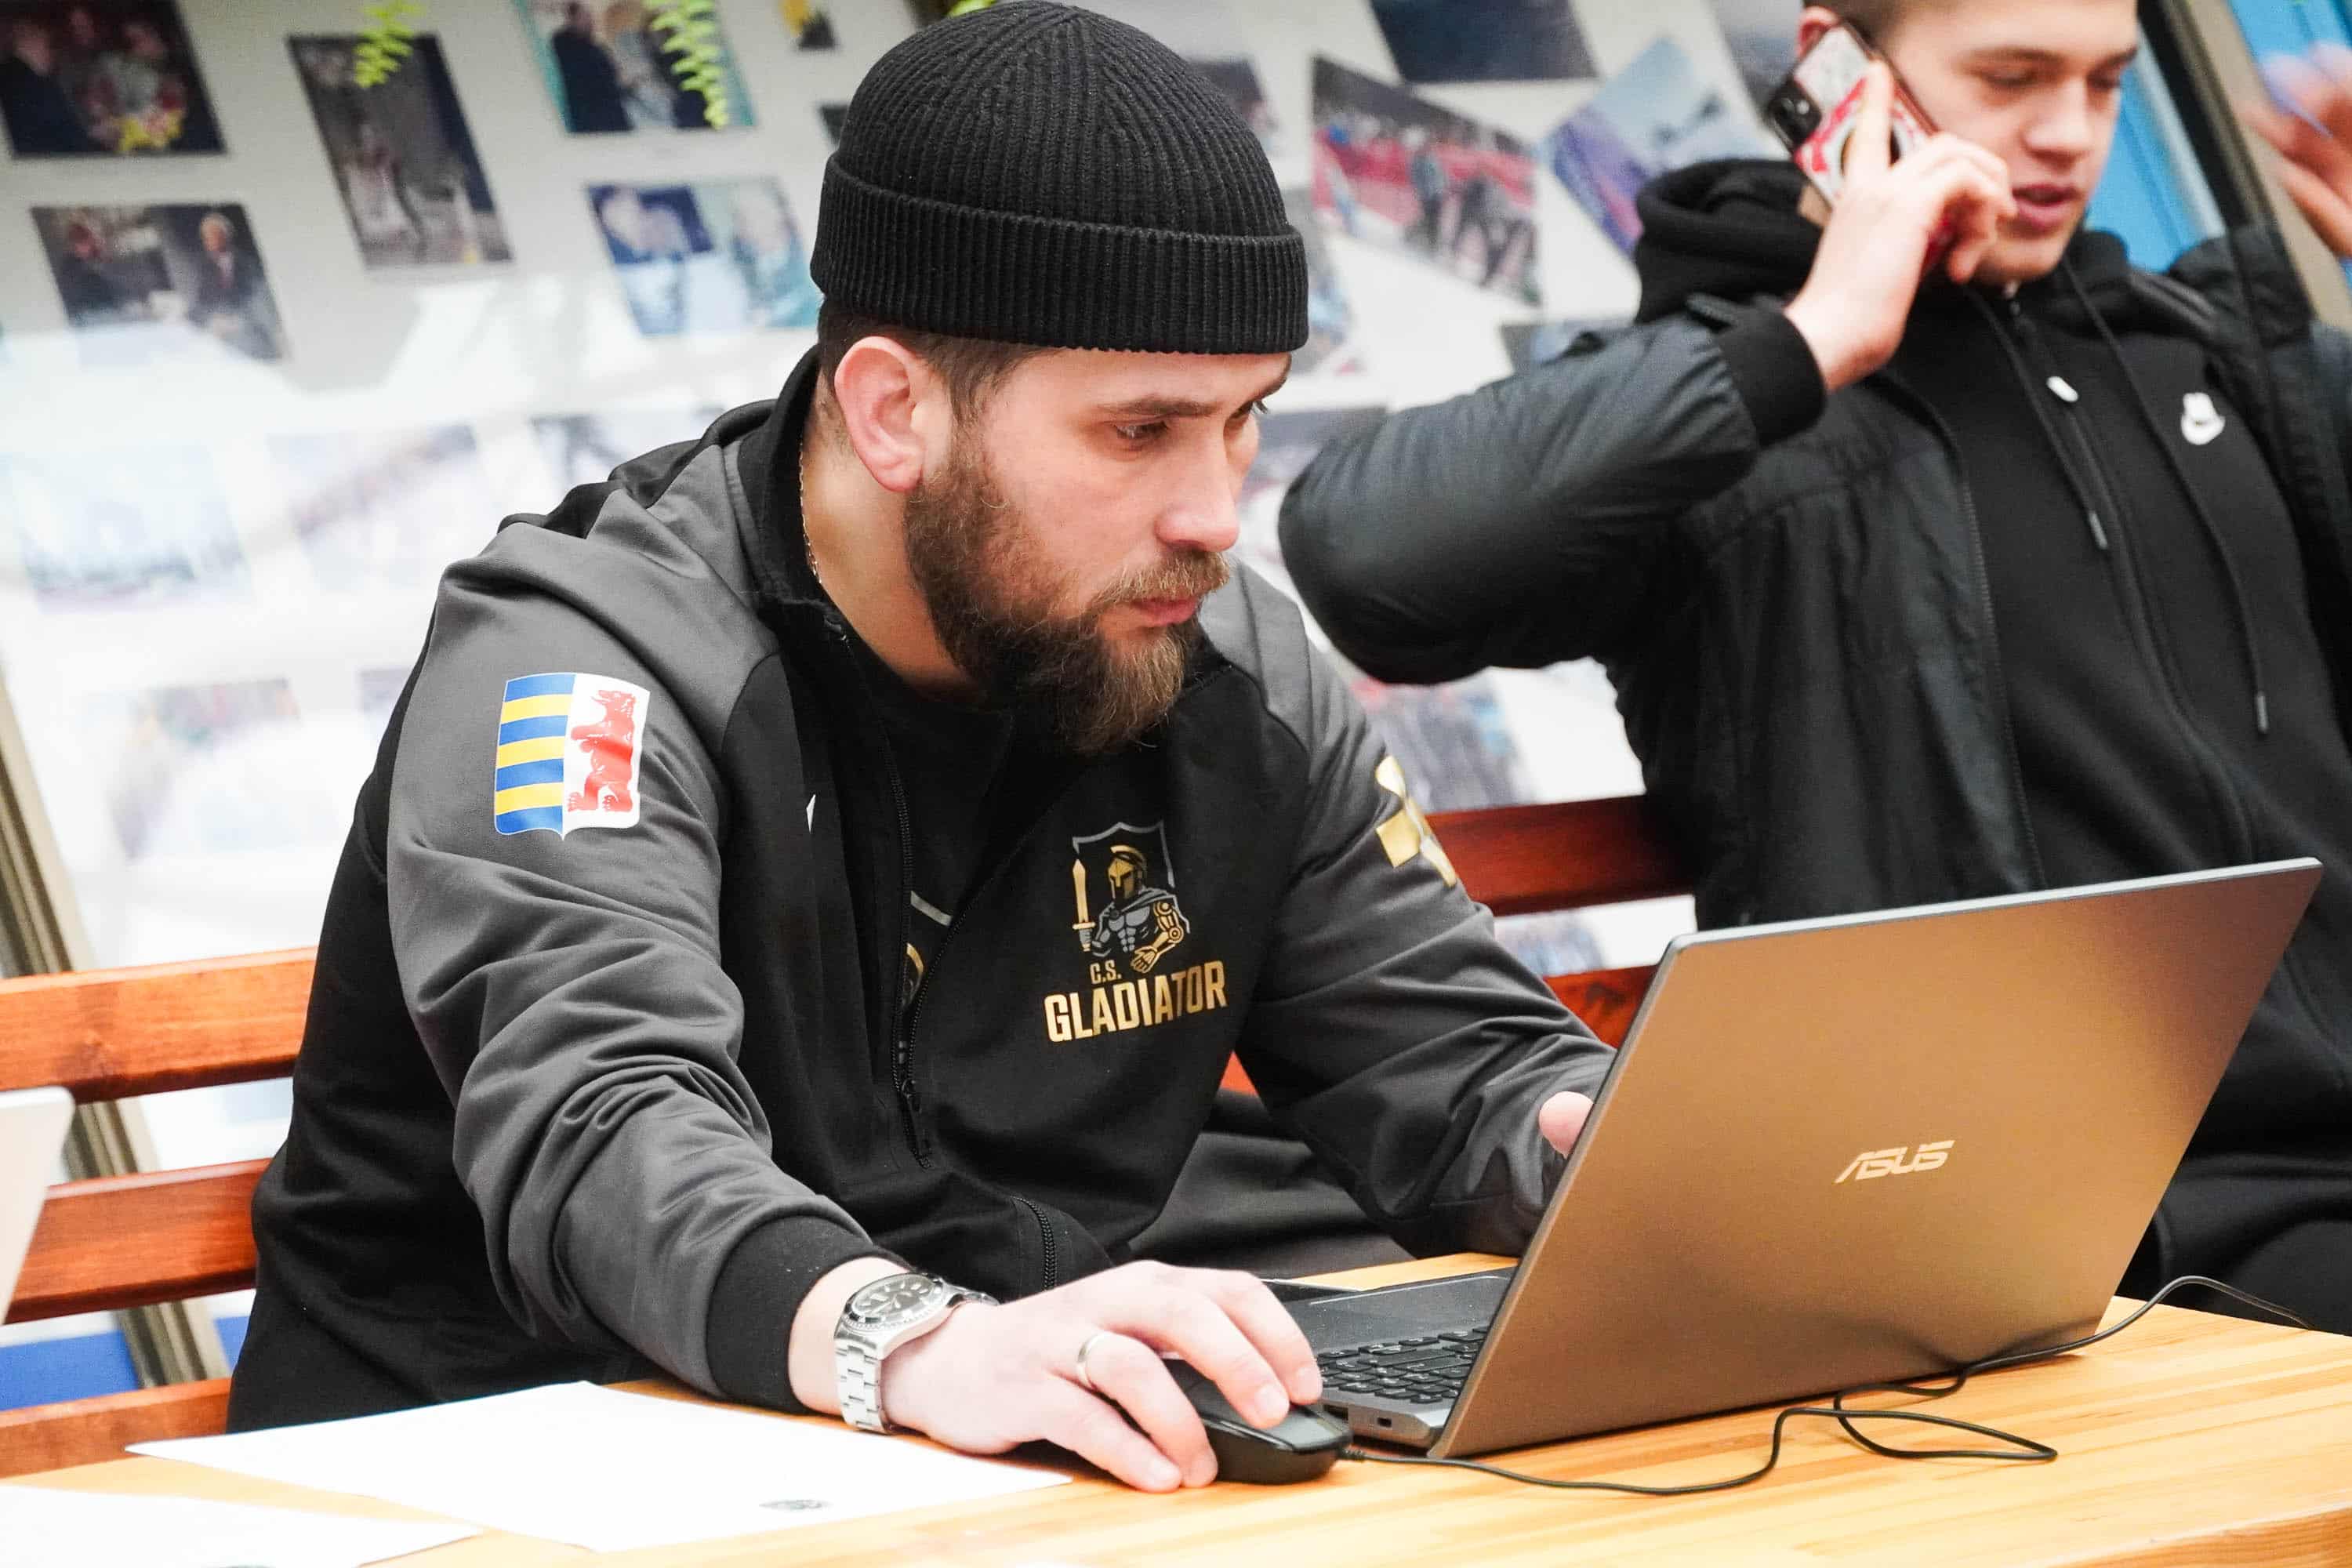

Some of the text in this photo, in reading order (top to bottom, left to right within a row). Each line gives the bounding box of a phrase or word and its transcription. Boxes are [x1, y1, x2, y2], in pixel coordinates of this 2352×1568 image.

[1089, 960, 1122, 984] C.S.
[1044, 960, 1228, 1042] GLADIATOR
[1834, 1140, 1955, 1183] ASUS
